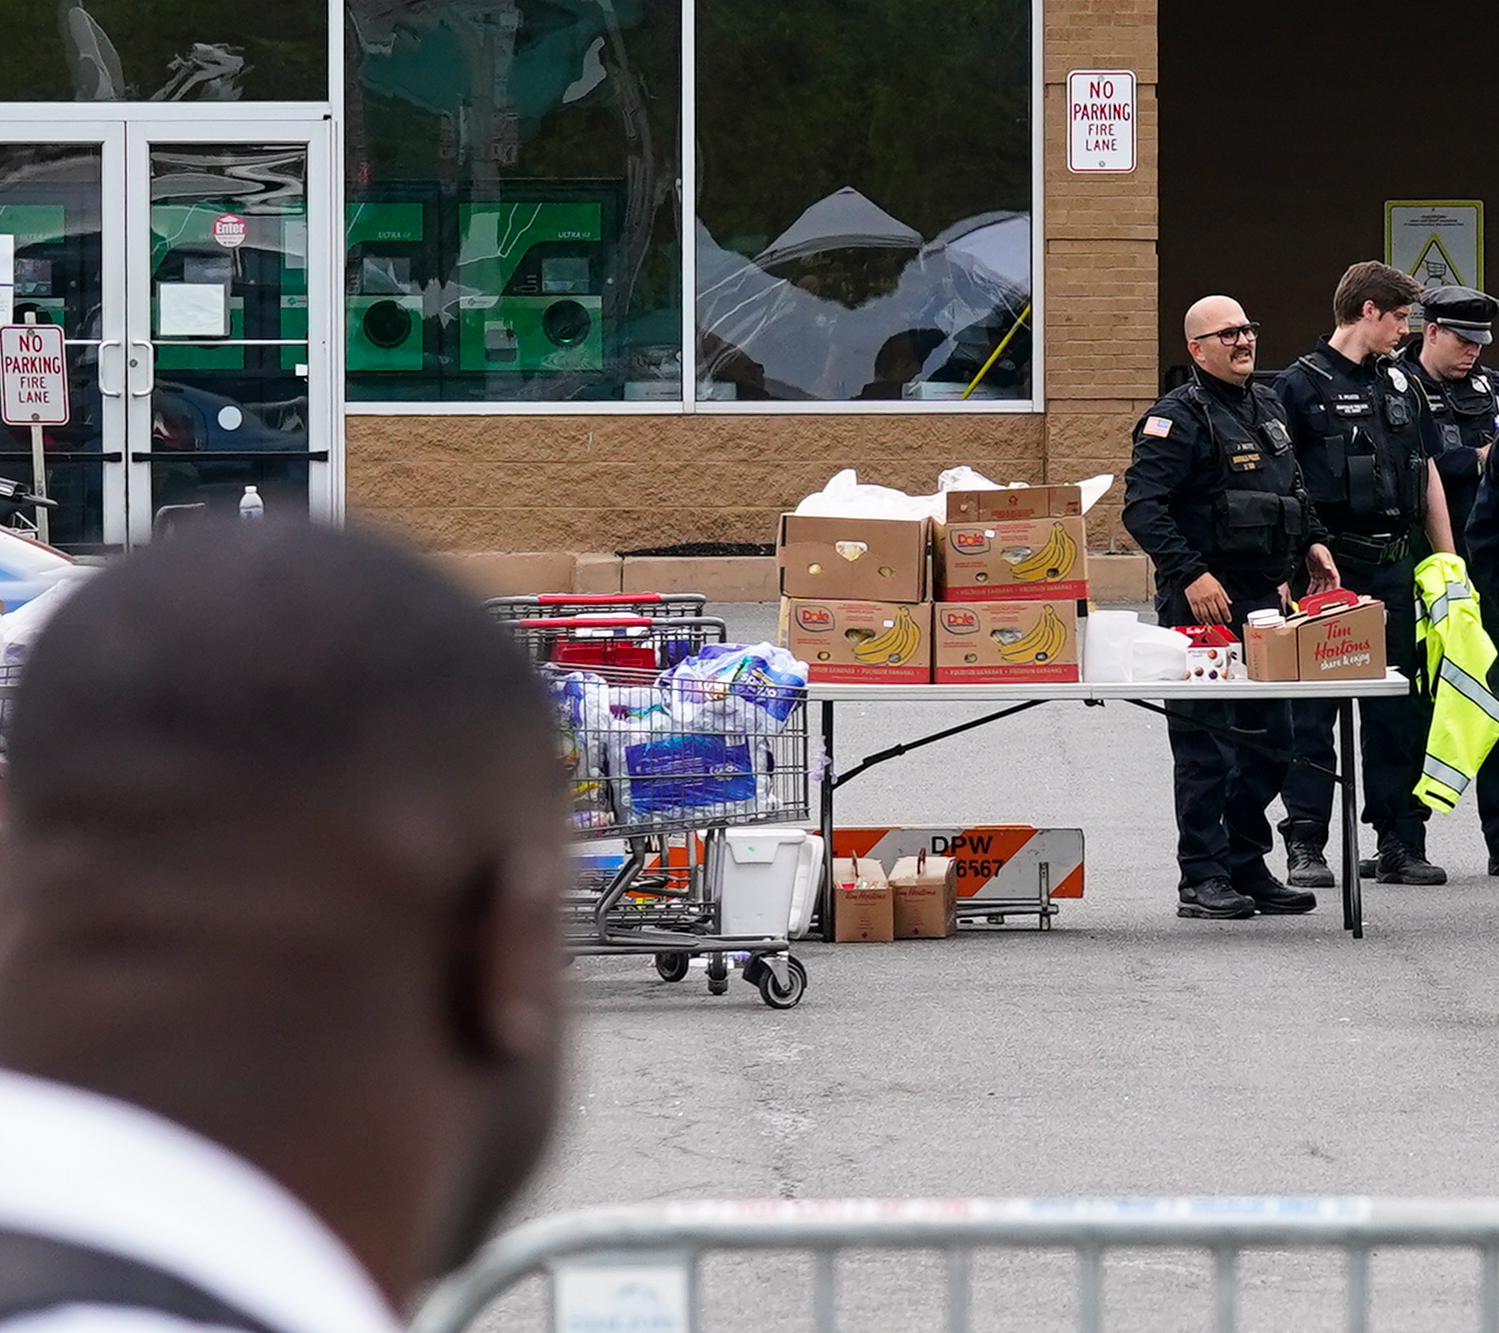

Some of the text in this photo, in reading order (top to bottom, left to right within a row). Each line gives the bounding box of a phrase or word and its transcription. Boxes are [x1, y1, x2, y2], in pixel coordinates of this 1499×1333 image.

[1090, 80, 1114, 99] NO
[1073, 103, 1130, 121] PARKING
[1088, 123, 1115, 136] FIRE
[1085, 138, 1118, 151] LANE
[215, 222, 245, 235] Enter
[19, 335, 43, 353] NO
[5, 356, 61, 374] PARKING
[20, 376, 46, 389] FIRE
[18, 391, 50, 404] LANE
[802, 610, 830, 622] Dole
[947, 613, 975, 625] Dole
[1322, 620, 1351, 640] Tim
[1314, 639, 1371, 662] Hortons
[1320, 658, 1342, 671] share
[1349, 652, 1370, 667] enjoy
[930, 836, 993, 854] DPW
